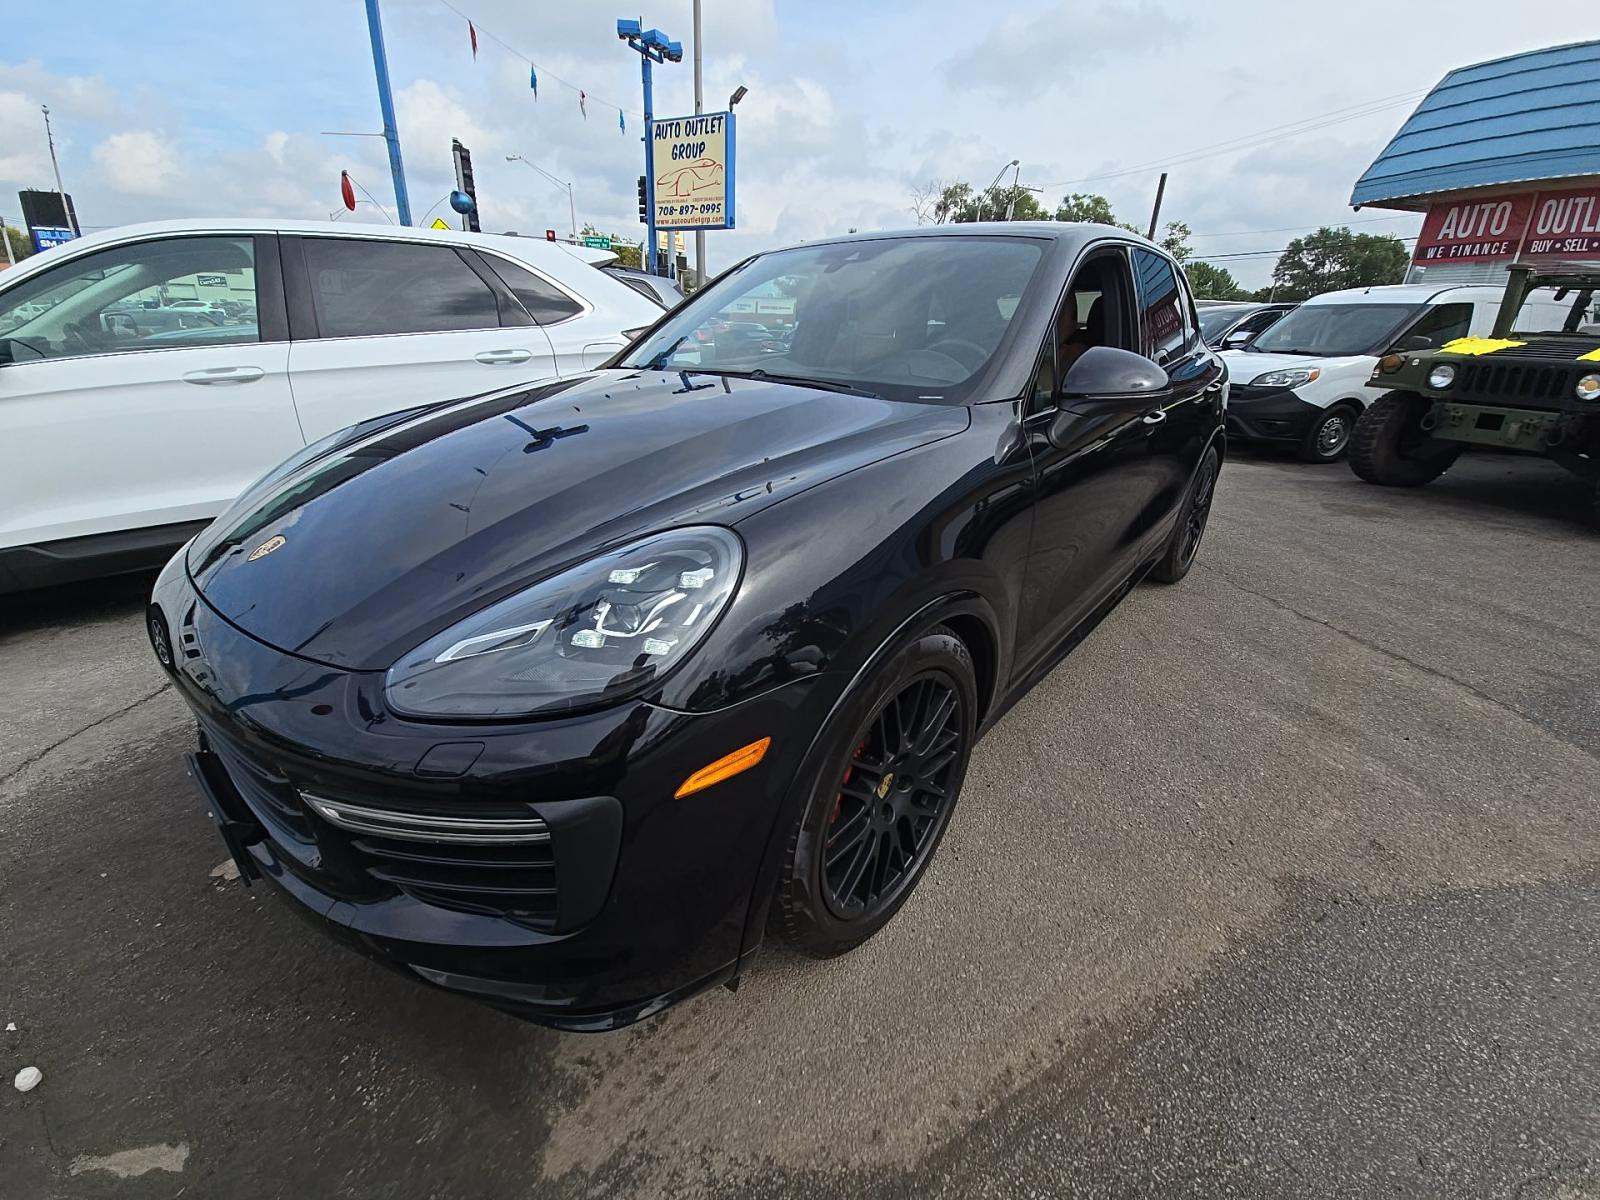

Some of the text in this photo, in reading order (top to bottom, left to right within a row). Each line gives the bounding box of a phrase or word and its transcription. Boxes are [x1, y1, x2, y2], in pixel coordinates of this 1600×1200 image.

[655, 116, 724, 140] AUTO OUTLET
[672, 141, 706, 160] GROUP
[1437, 201, 1513, 241] AUTO
[1426, 241, 1510, 259] WE FINANCE
[1530, 239, 1588, 253] BUY SELL
